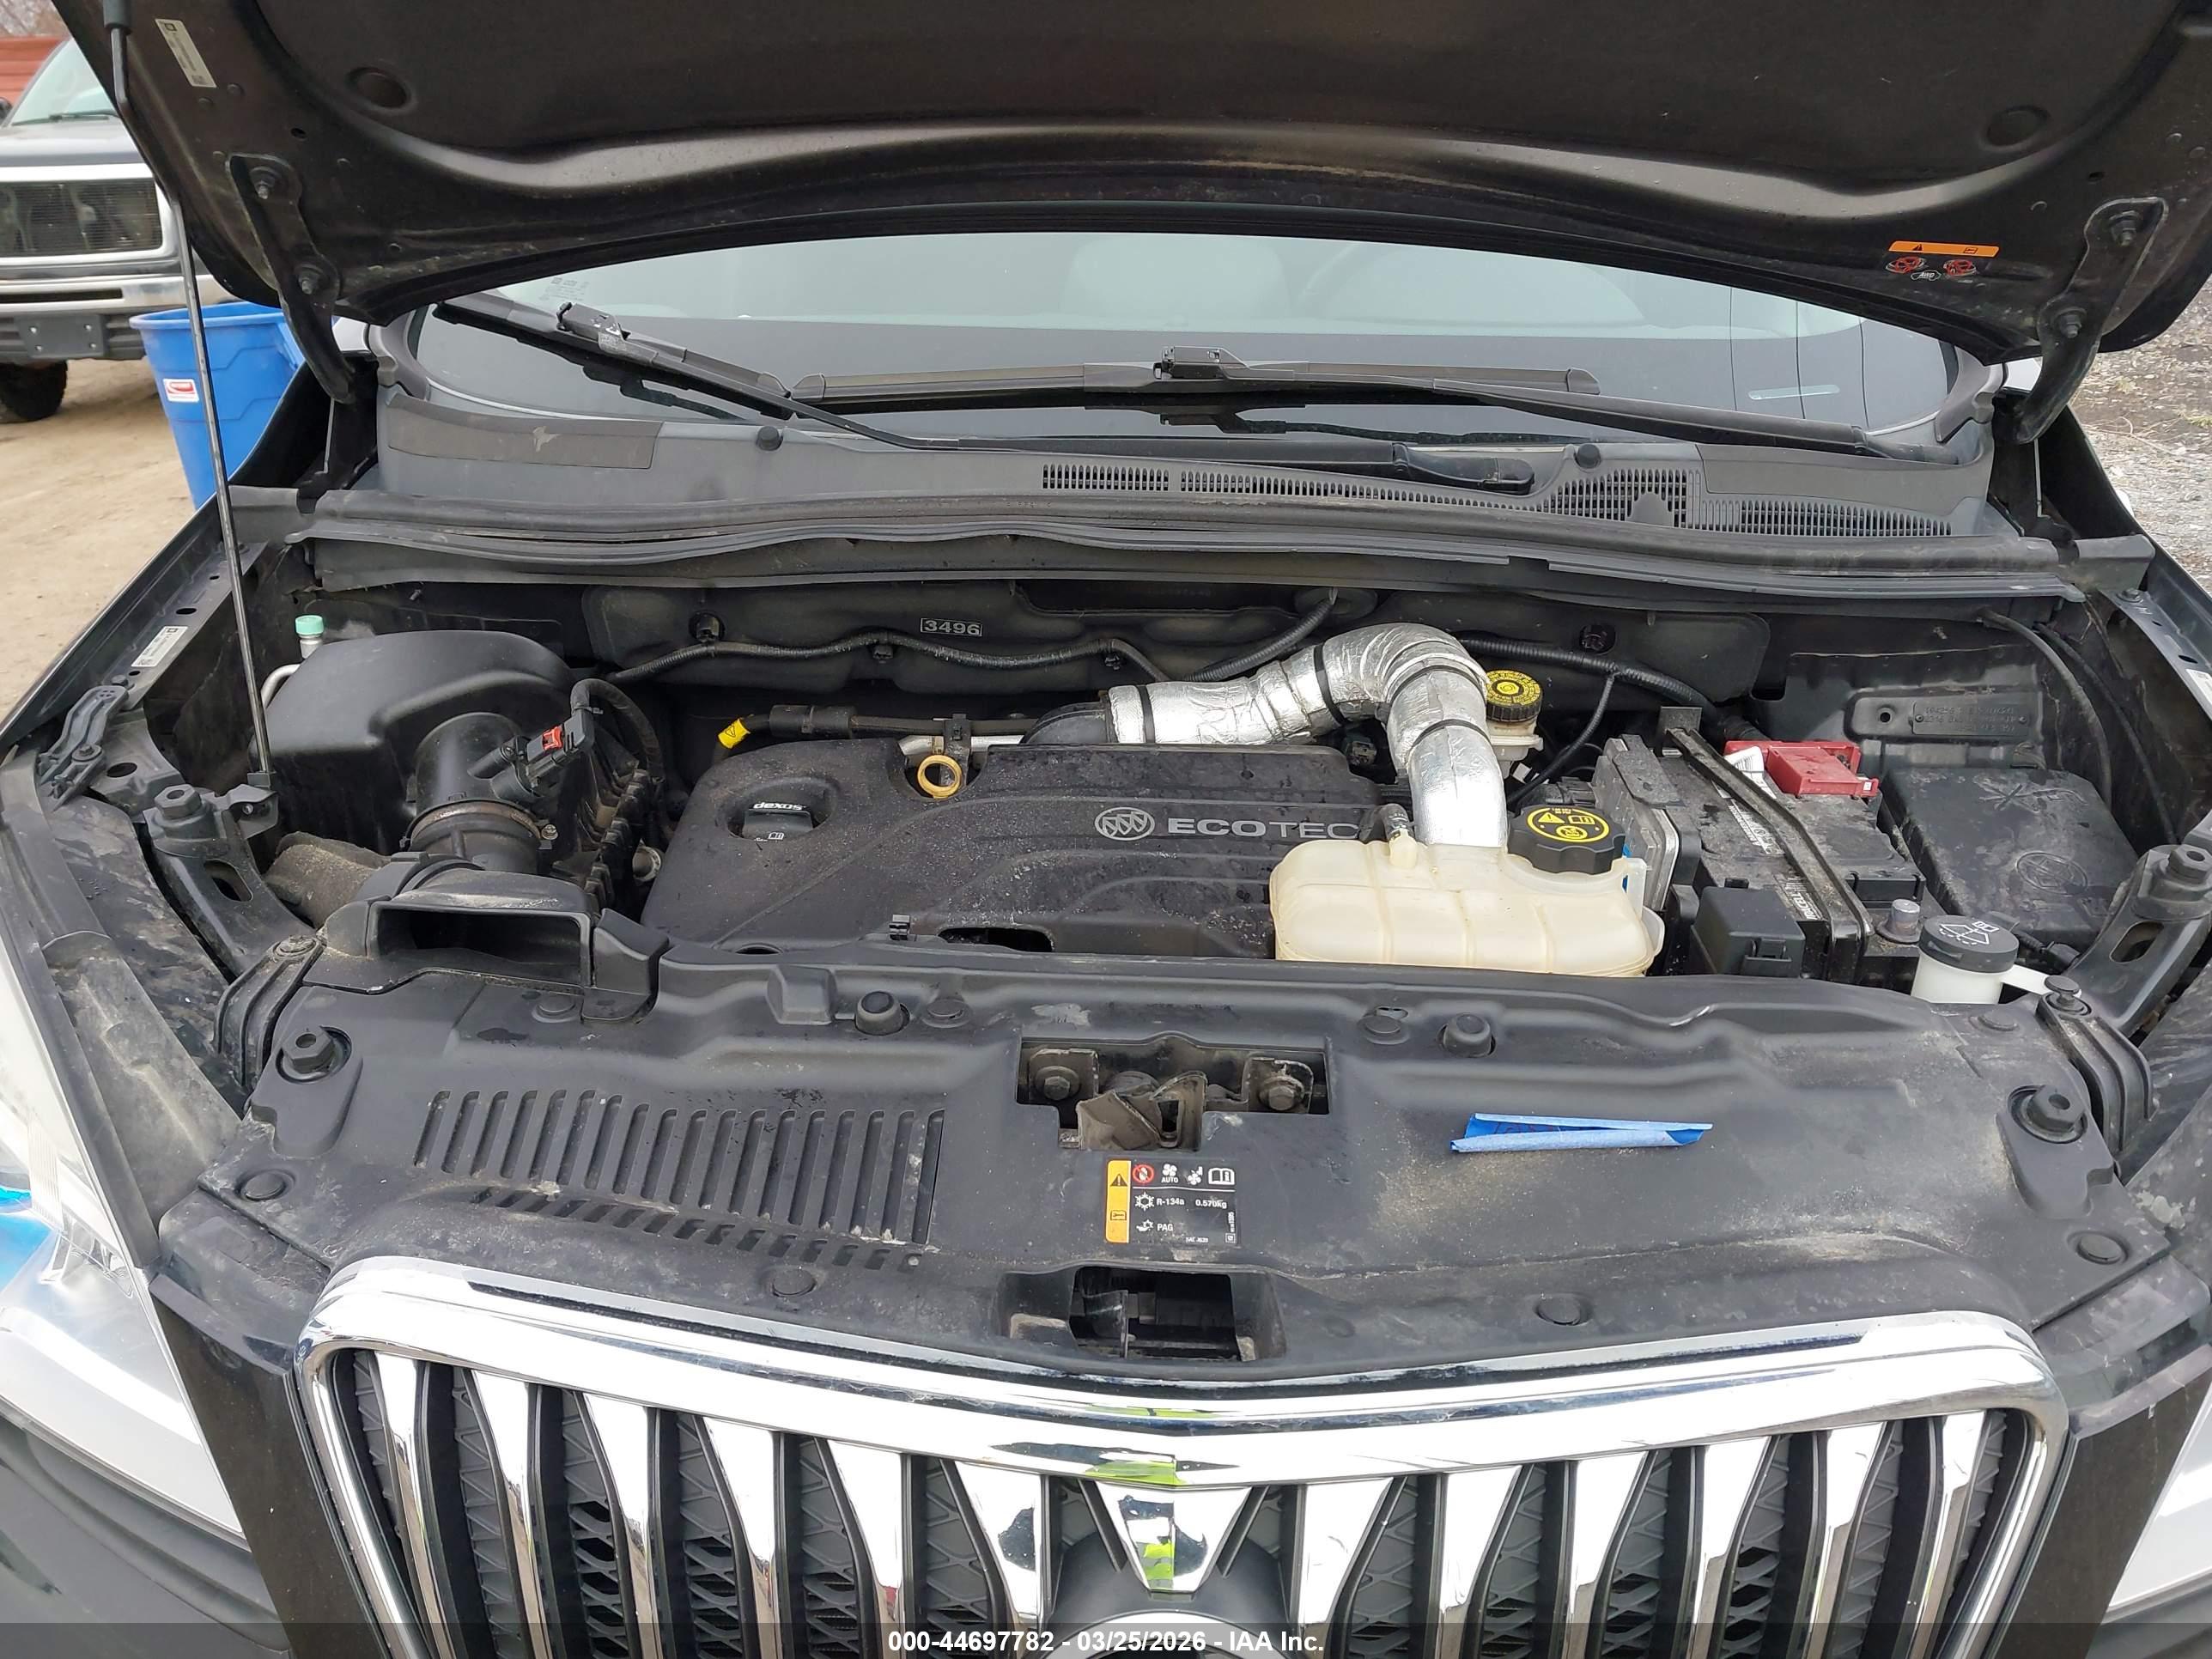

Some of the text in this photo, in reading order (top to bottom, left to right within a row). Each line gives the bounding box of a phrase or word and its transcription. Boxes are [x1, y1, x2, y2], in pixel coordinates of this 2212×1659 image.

[925, 620, 980, 635] 3496
[753, 802, 803, 811] dexos
[1168, 817, 1360, 840] ECOTEC
[1156, 1197, 1228, 1210] R-134a 0.570kg
[1157, 1223, 1174, 1231] PAG
